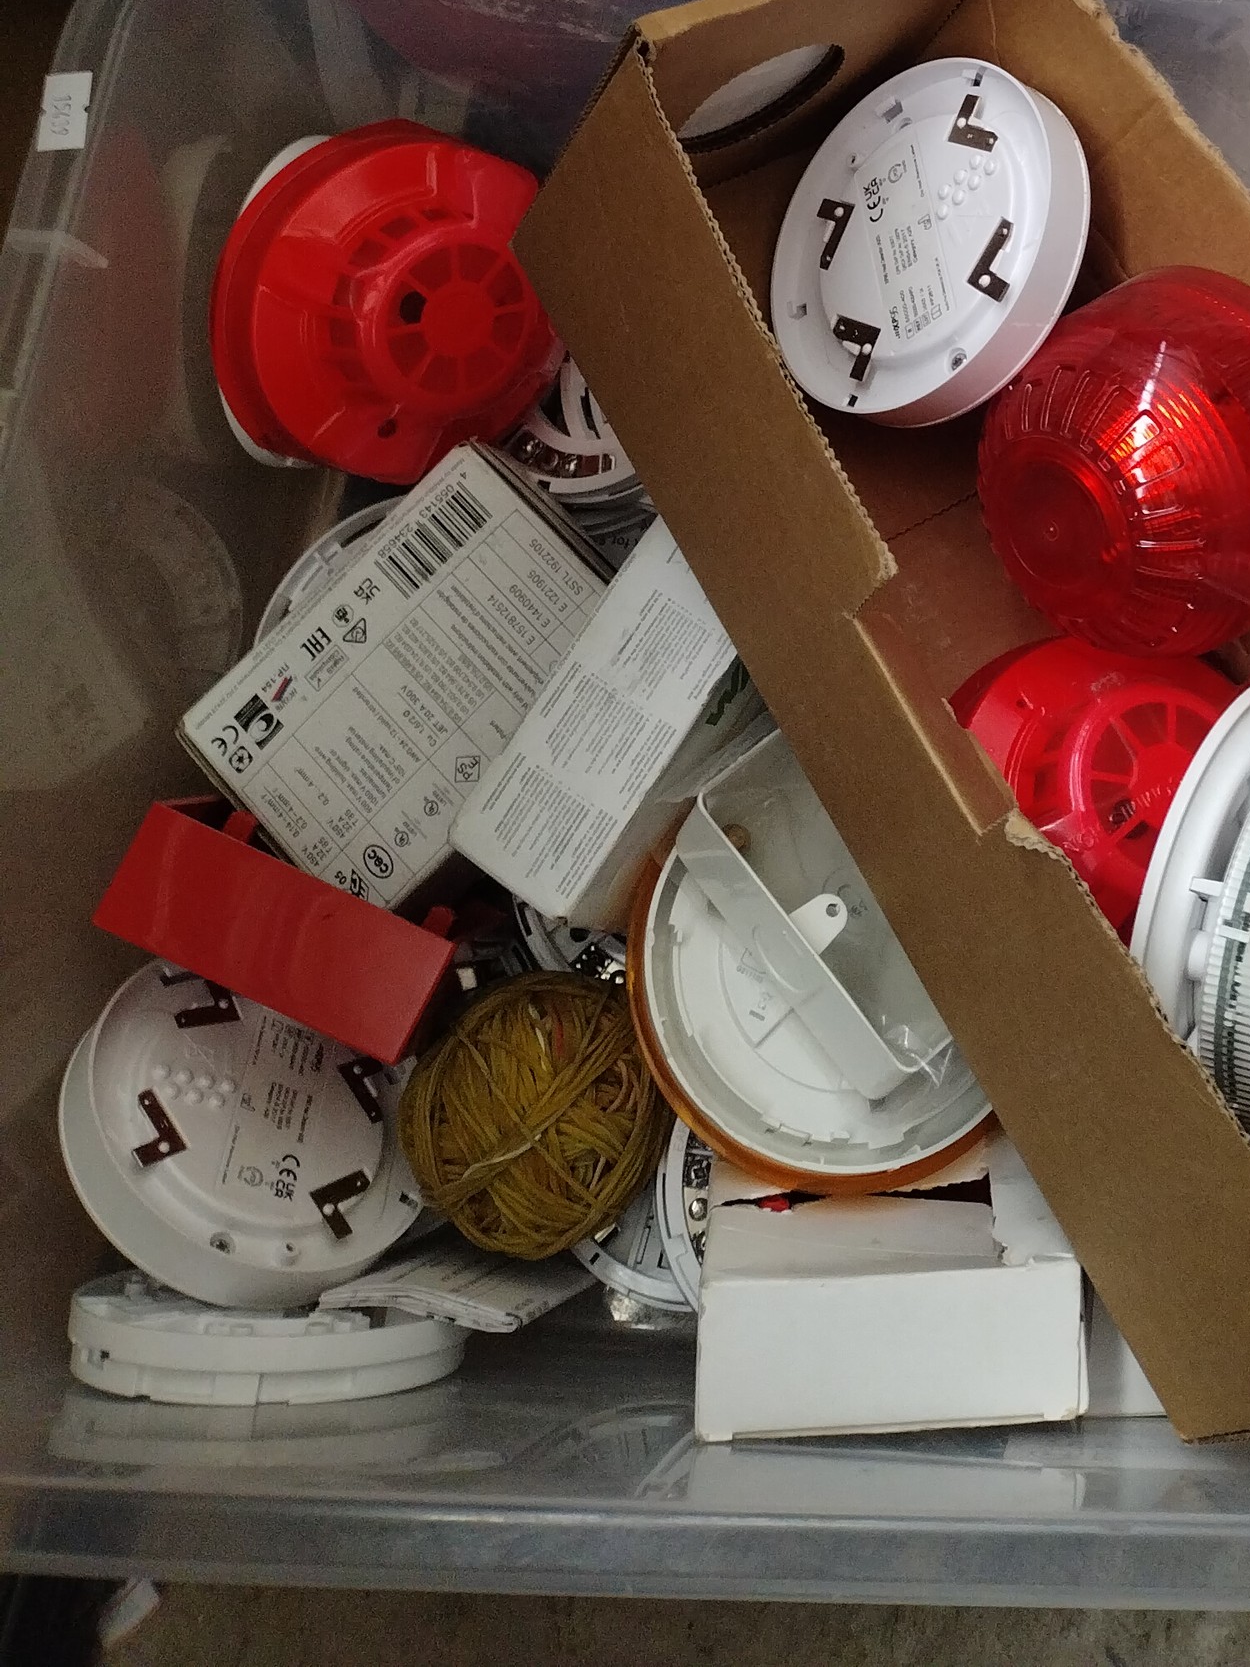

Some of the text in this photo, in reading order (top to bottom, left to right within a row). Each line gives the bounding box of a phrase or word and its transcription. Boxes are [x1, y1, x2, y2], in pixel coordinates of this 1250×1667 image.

[376, 469, 468, 560] 4 055143 234658
[527, 537, 584, 596] SSTL 1922105
[484, 593, 535, 645] E 157812514
[506, 582, 551, 628] E 1440909
[557, 601, 568, 612] E
[404, 689, 421, 706] 300
[356, 752, 397, 792] Temperature
[405, 747, 422, 764] AWG
[332, 869, 348, 885] 05
